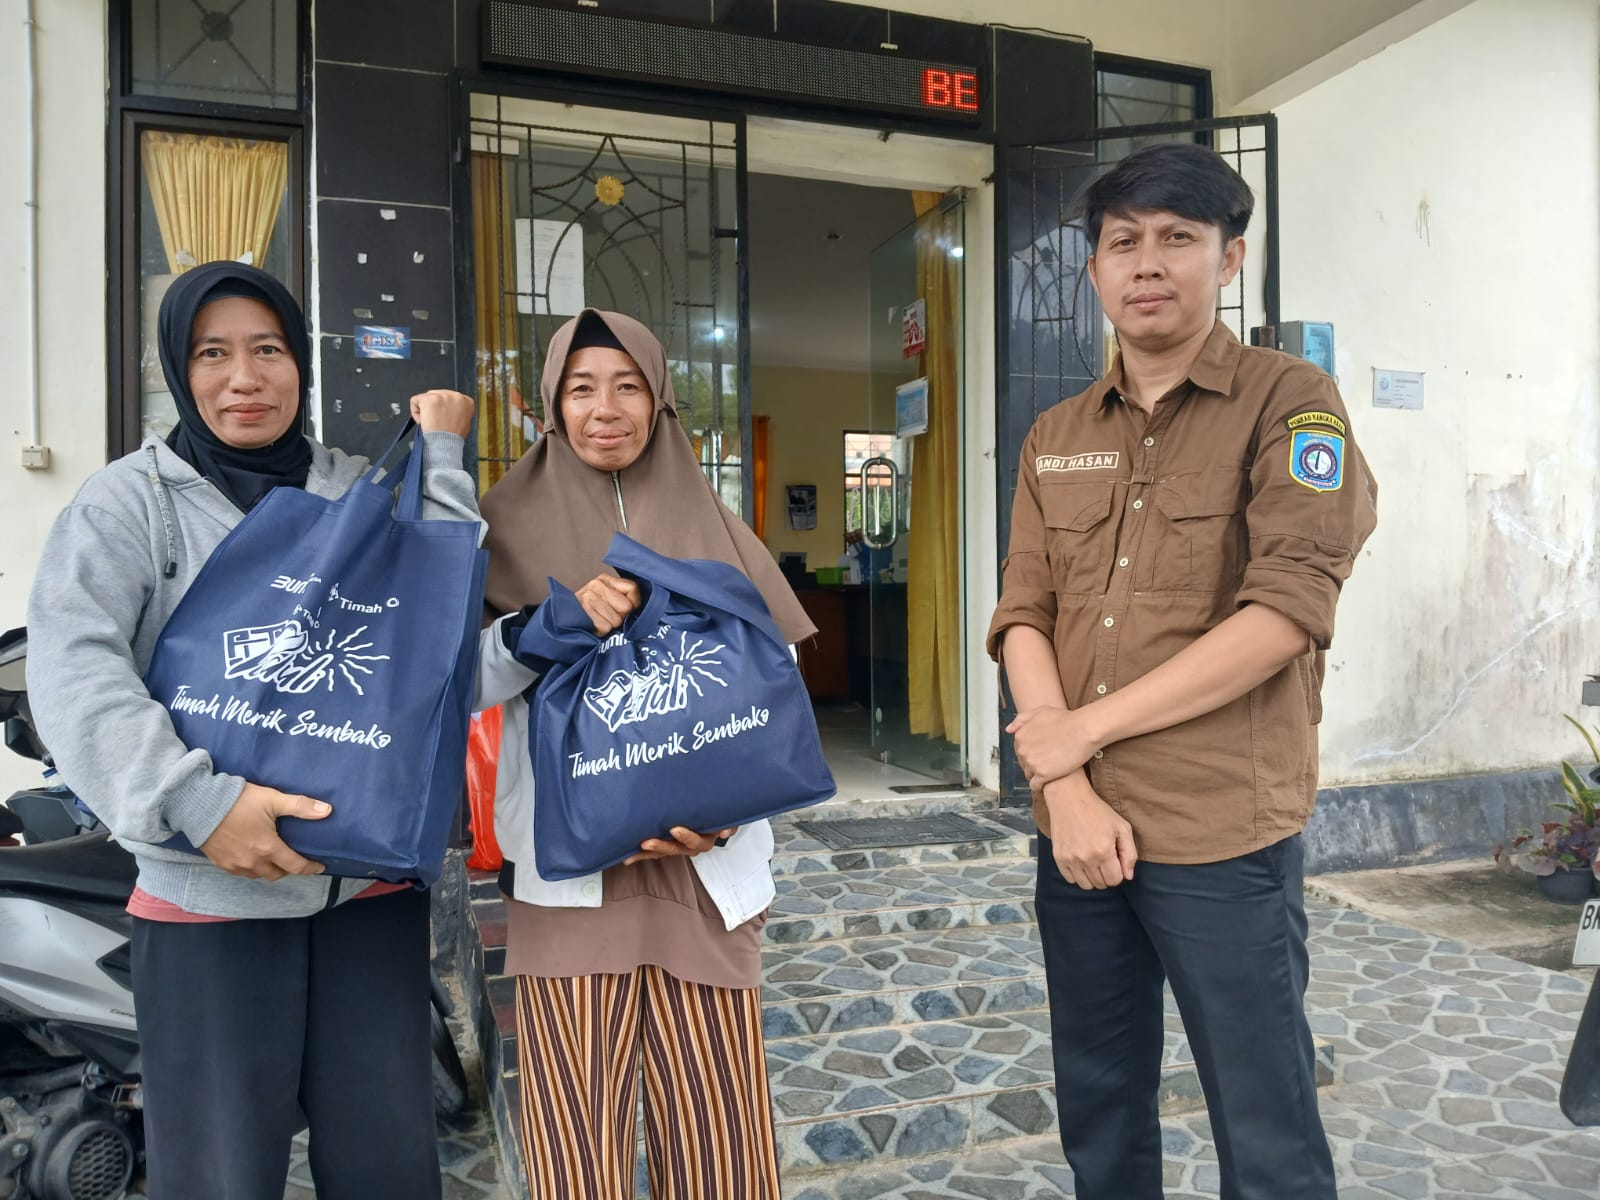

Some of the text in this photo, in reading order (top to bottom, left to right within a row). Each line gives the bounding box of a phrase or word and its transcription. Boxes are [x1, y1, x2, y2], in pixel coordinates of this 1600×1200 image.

[926, 69, 978, 109] BE
[1038, 456, 1113, 469] ANDI HASAN
[340, 597, 383, 613] Timah
[170, 685, 392, 749] Timah Merik Sembako
[568, 705, 769, 779] Timah Merik Sembako
